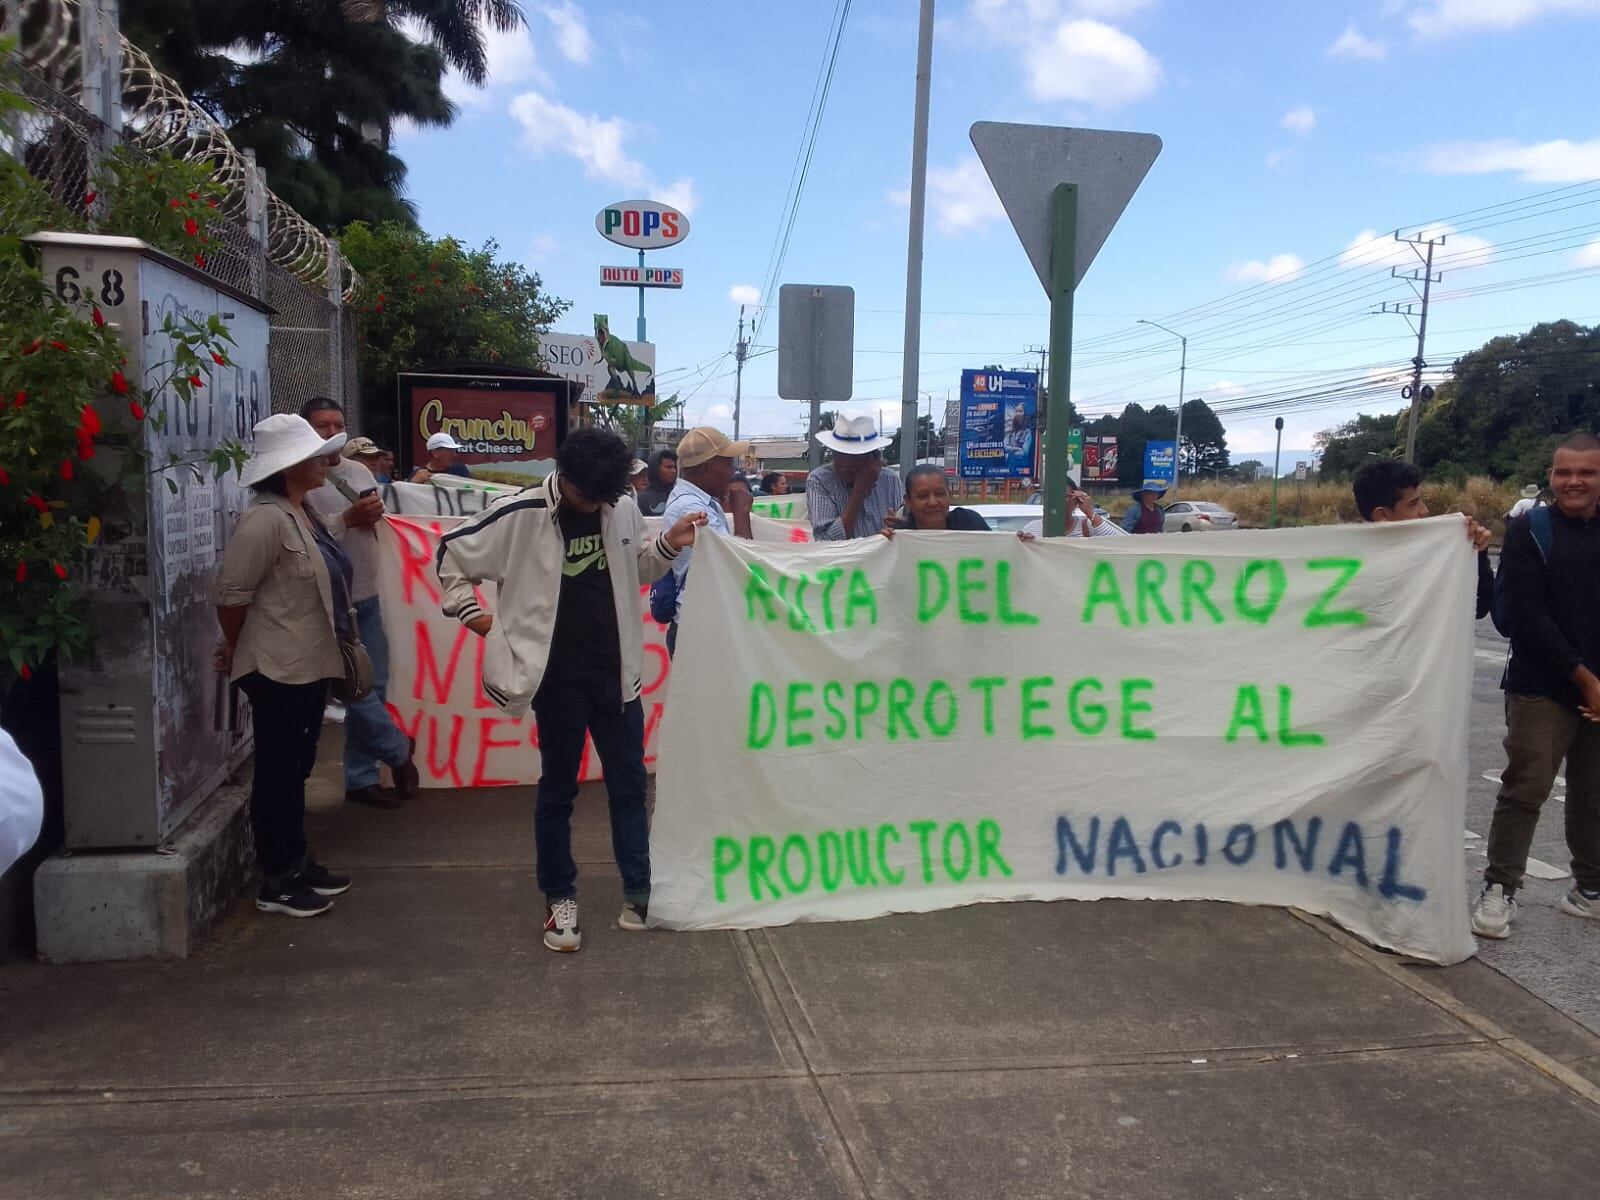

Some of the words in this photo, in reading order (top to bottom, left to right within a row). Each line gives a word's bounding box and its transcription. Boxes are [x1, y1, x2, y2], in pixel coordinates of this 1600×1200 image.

[604, 208, 679, 238] POPS
[603, 267, 639, 282] AUTO
[645, 269, 682, 283] POPS
[419, 399, 536, 450] Crunchy
[476, 441, 523, 453] Cheese
[566, 534, 601, 557] JUST
[917, 558, 1039, 624] DEL
[1082, 557, 1368, 627] ARROZ
[748, 676, 1158, 750] DESPROTEGE
[1225, 684, 1326, 746] AL
[713, 818, 1013, 903] PRODUCTOR
[1054, 815, 1427, 901] NACIONAL
